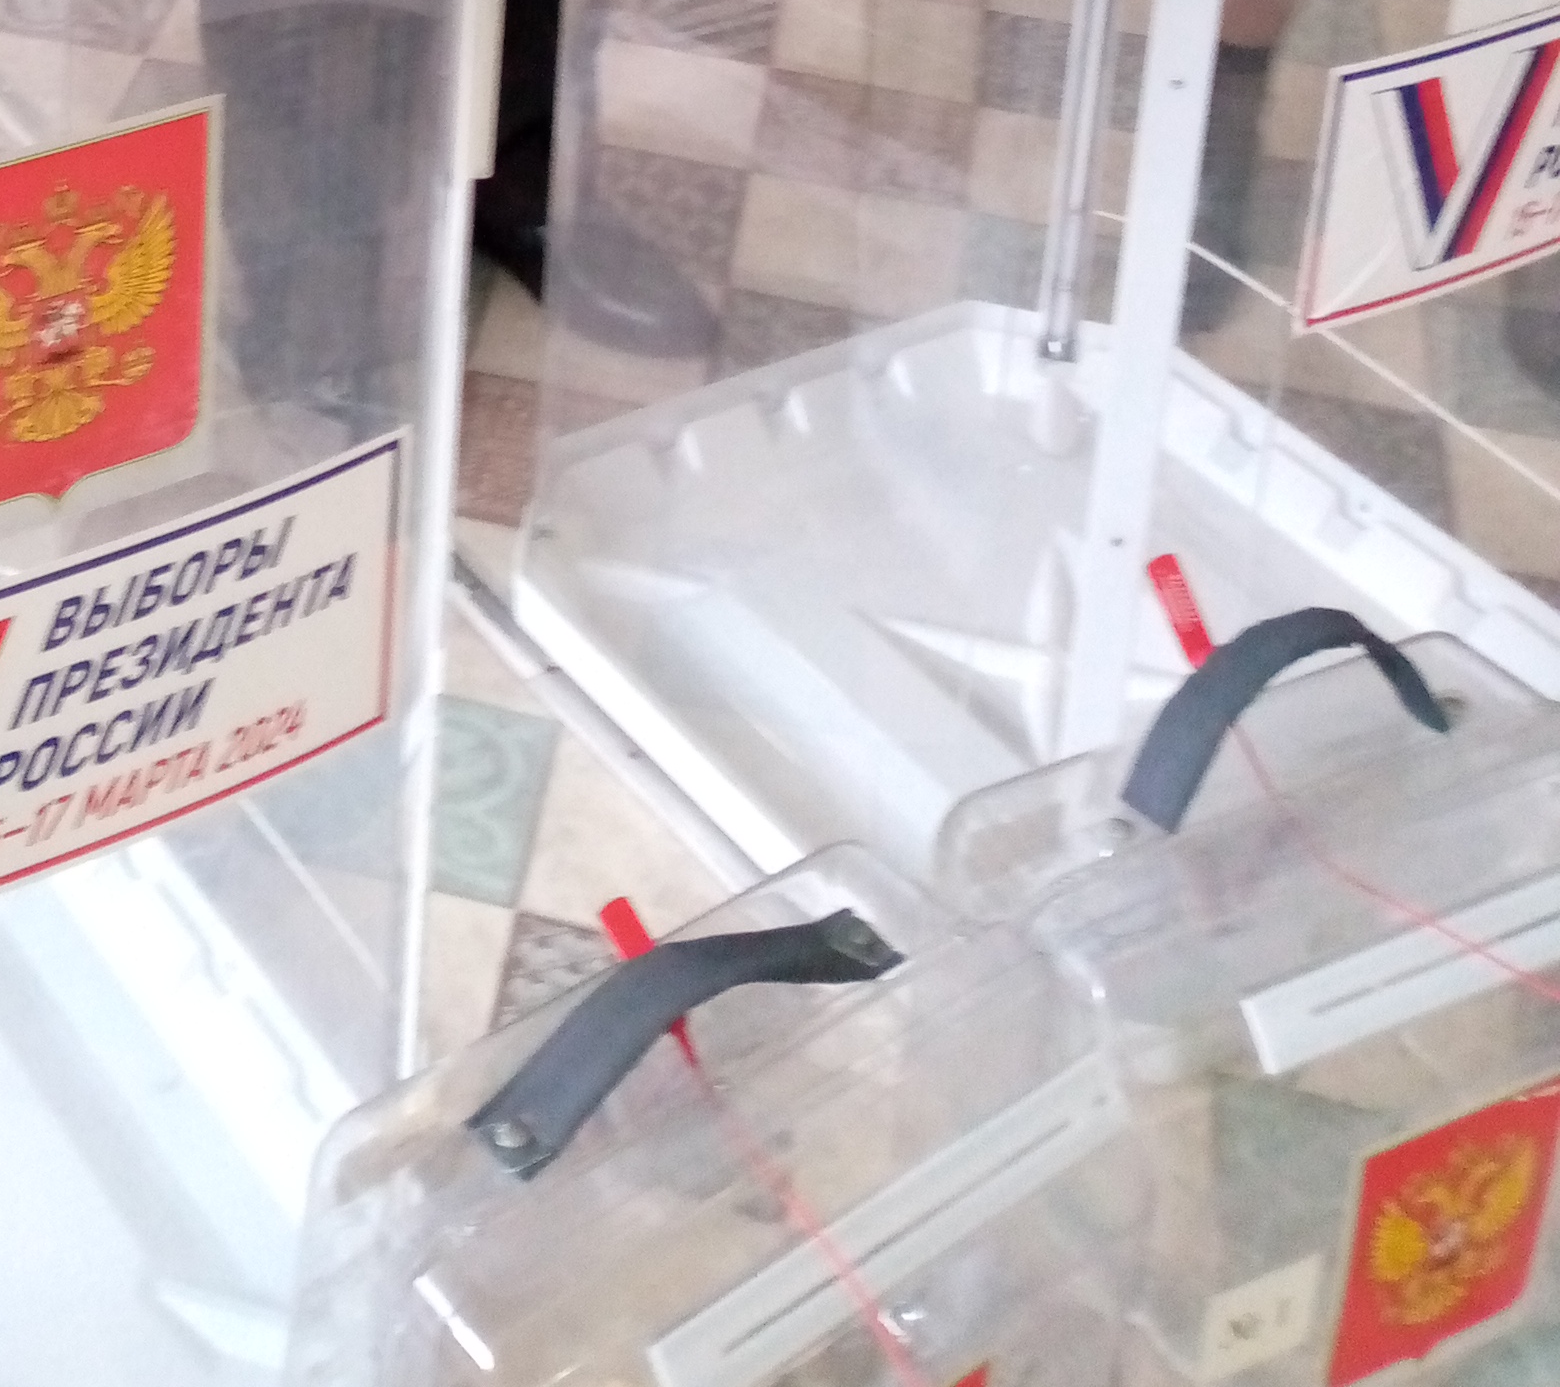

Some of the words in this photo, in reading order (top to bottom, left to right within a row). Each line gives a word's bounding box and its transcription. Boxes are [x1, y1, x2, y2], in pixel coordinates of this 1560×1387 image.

[8, 552, 358, 731] ПРЕЗИДЕНТА
[40, 514, 297, 653] ВЫБОРЫ
[74, 741, 210, 825] МАРТА
[215, 700, 306, 773] 2024
